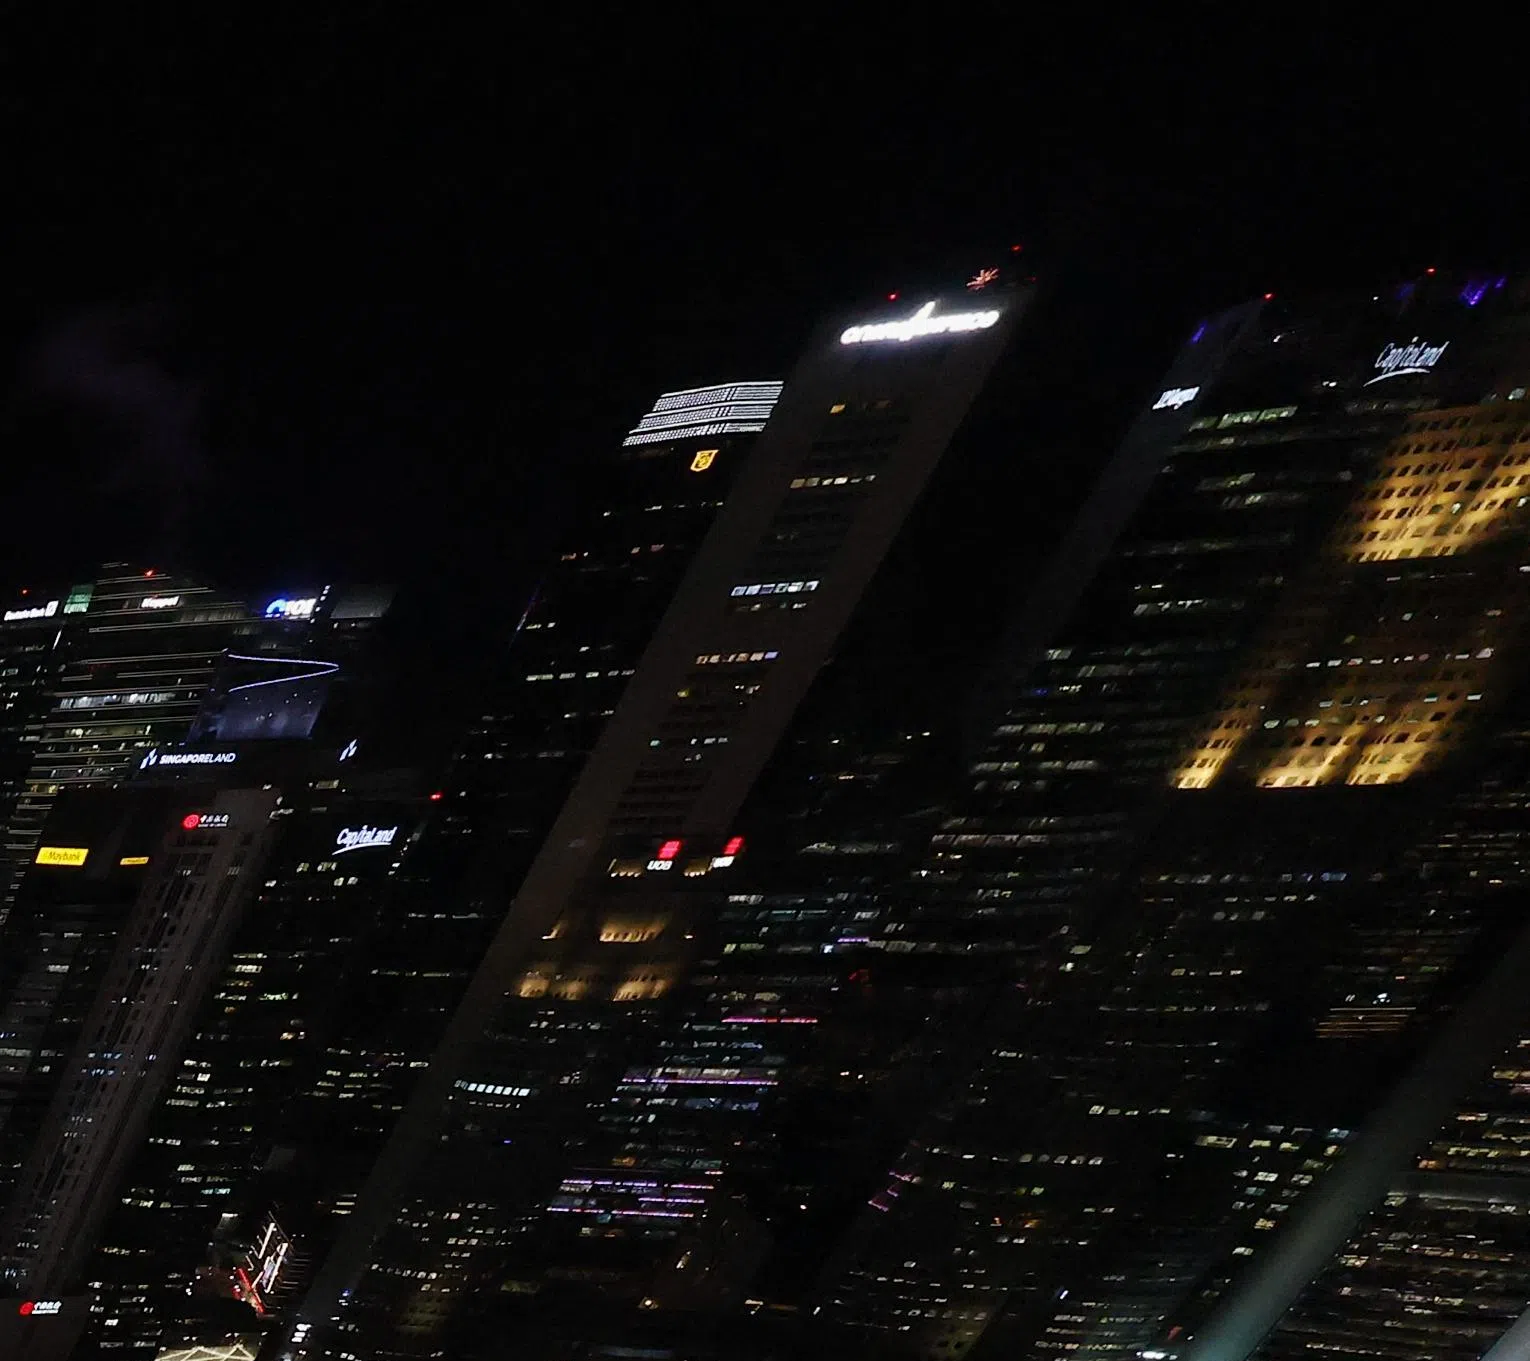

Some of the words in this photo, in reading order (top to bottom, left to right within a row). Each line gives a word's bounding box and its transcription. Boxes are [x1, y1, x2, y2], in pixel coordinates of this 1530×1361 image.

[1374, 337, 1449, 373] CapitaLand
[159, 752, 236, 765] SINGAPORELAND
[336, 825, 397, 847] CapitaLand
[47, 850, 82, 862] Maybank
[646, 860, 673, 871] UOB
